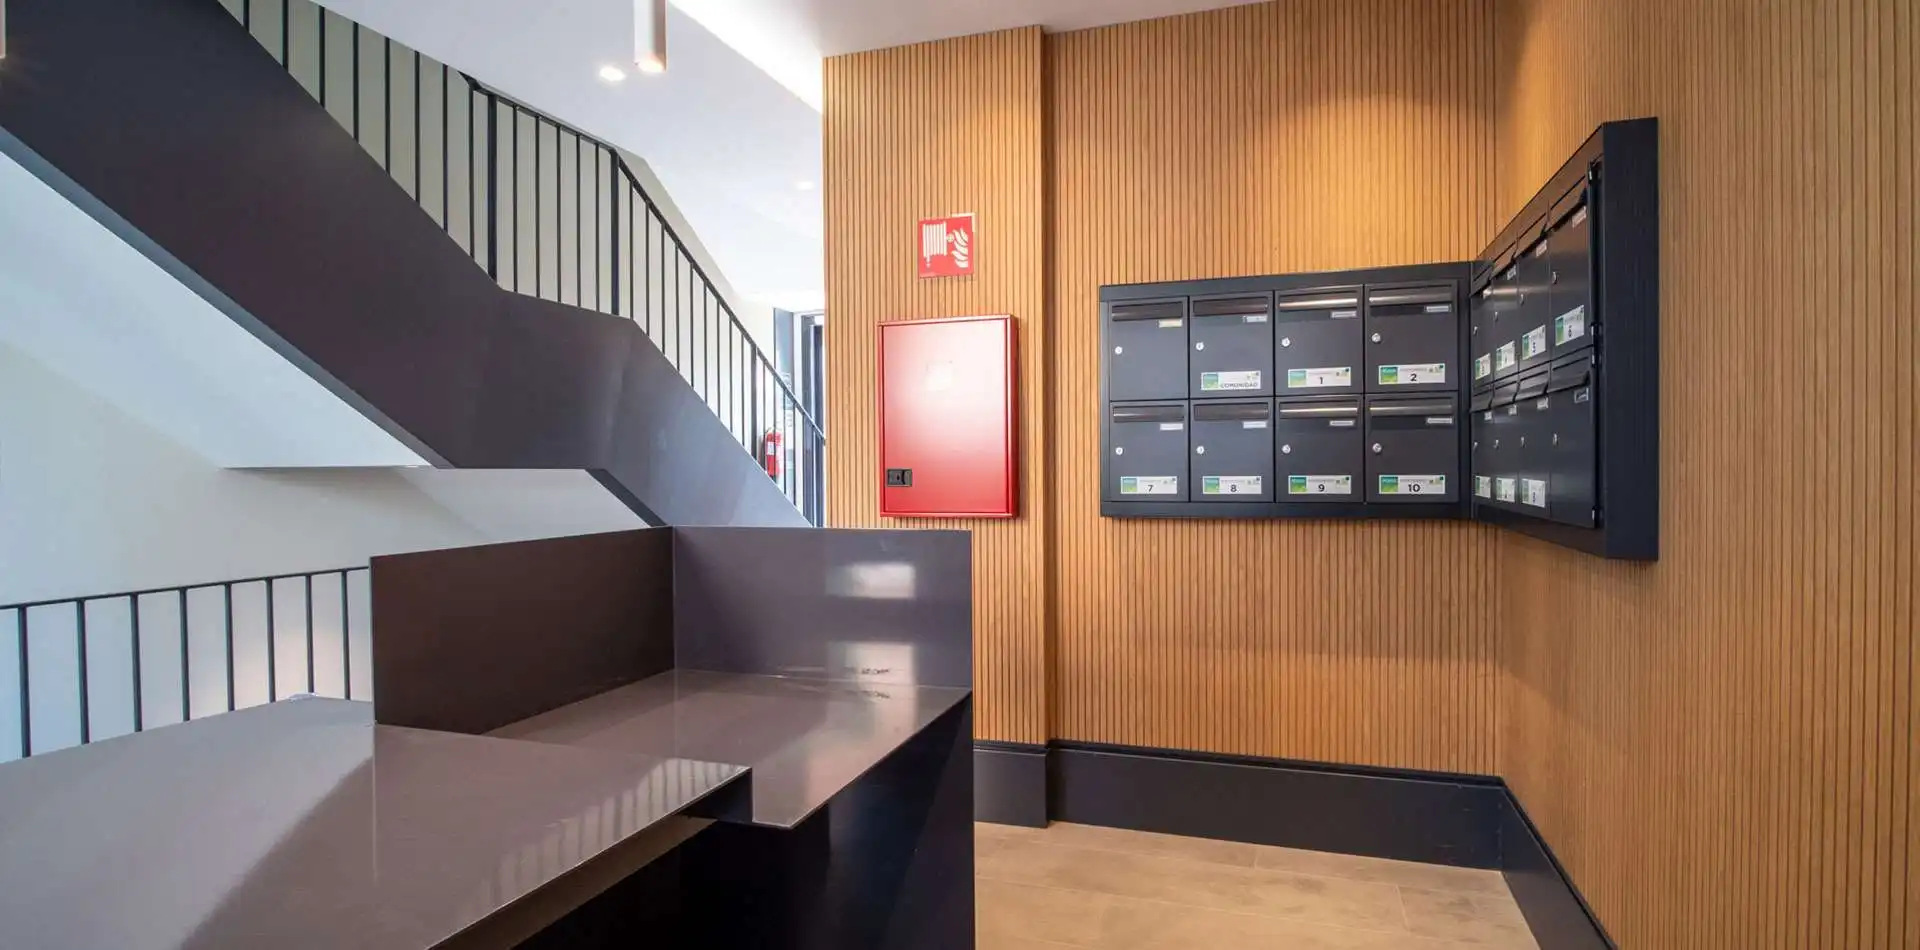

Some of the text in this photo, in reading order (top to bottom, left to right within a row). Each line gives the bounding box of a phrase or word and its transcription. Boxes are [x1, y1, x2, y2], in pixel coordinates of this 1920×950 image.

[1319, 376, 1324, 385] 1
[1410, 373, 1417, 382] 2
[1147, 484, 1153, 492] 7
[1230, 484, 1237, 492] 8
[1318, 483, 1325, 492] 9
[1408, 483, 1421, 493] 10
